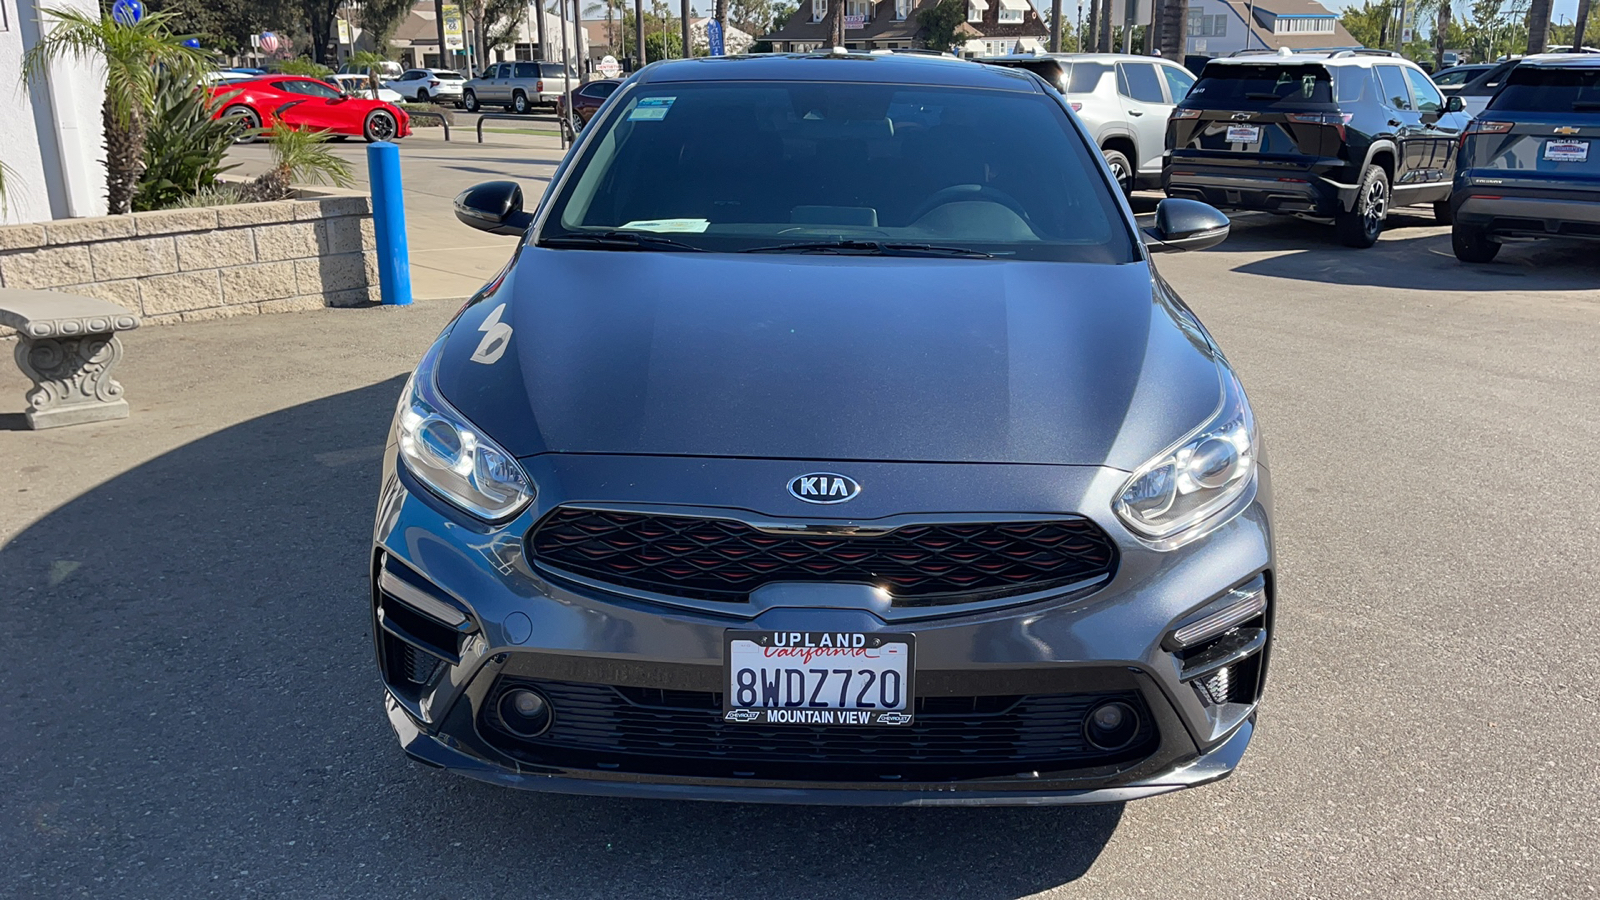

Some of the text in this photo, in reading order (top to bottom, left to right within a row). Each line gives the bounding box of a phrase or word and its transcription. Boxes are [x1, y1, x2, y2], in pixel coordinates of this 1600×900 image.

[801, 477, 848, 496] KIA
[774, 632, 866, 648] UPLAND
[737, 668, 901, 708] 8WDZ720
[767, 709, 871, 724] MOUNTAIN VIEW
